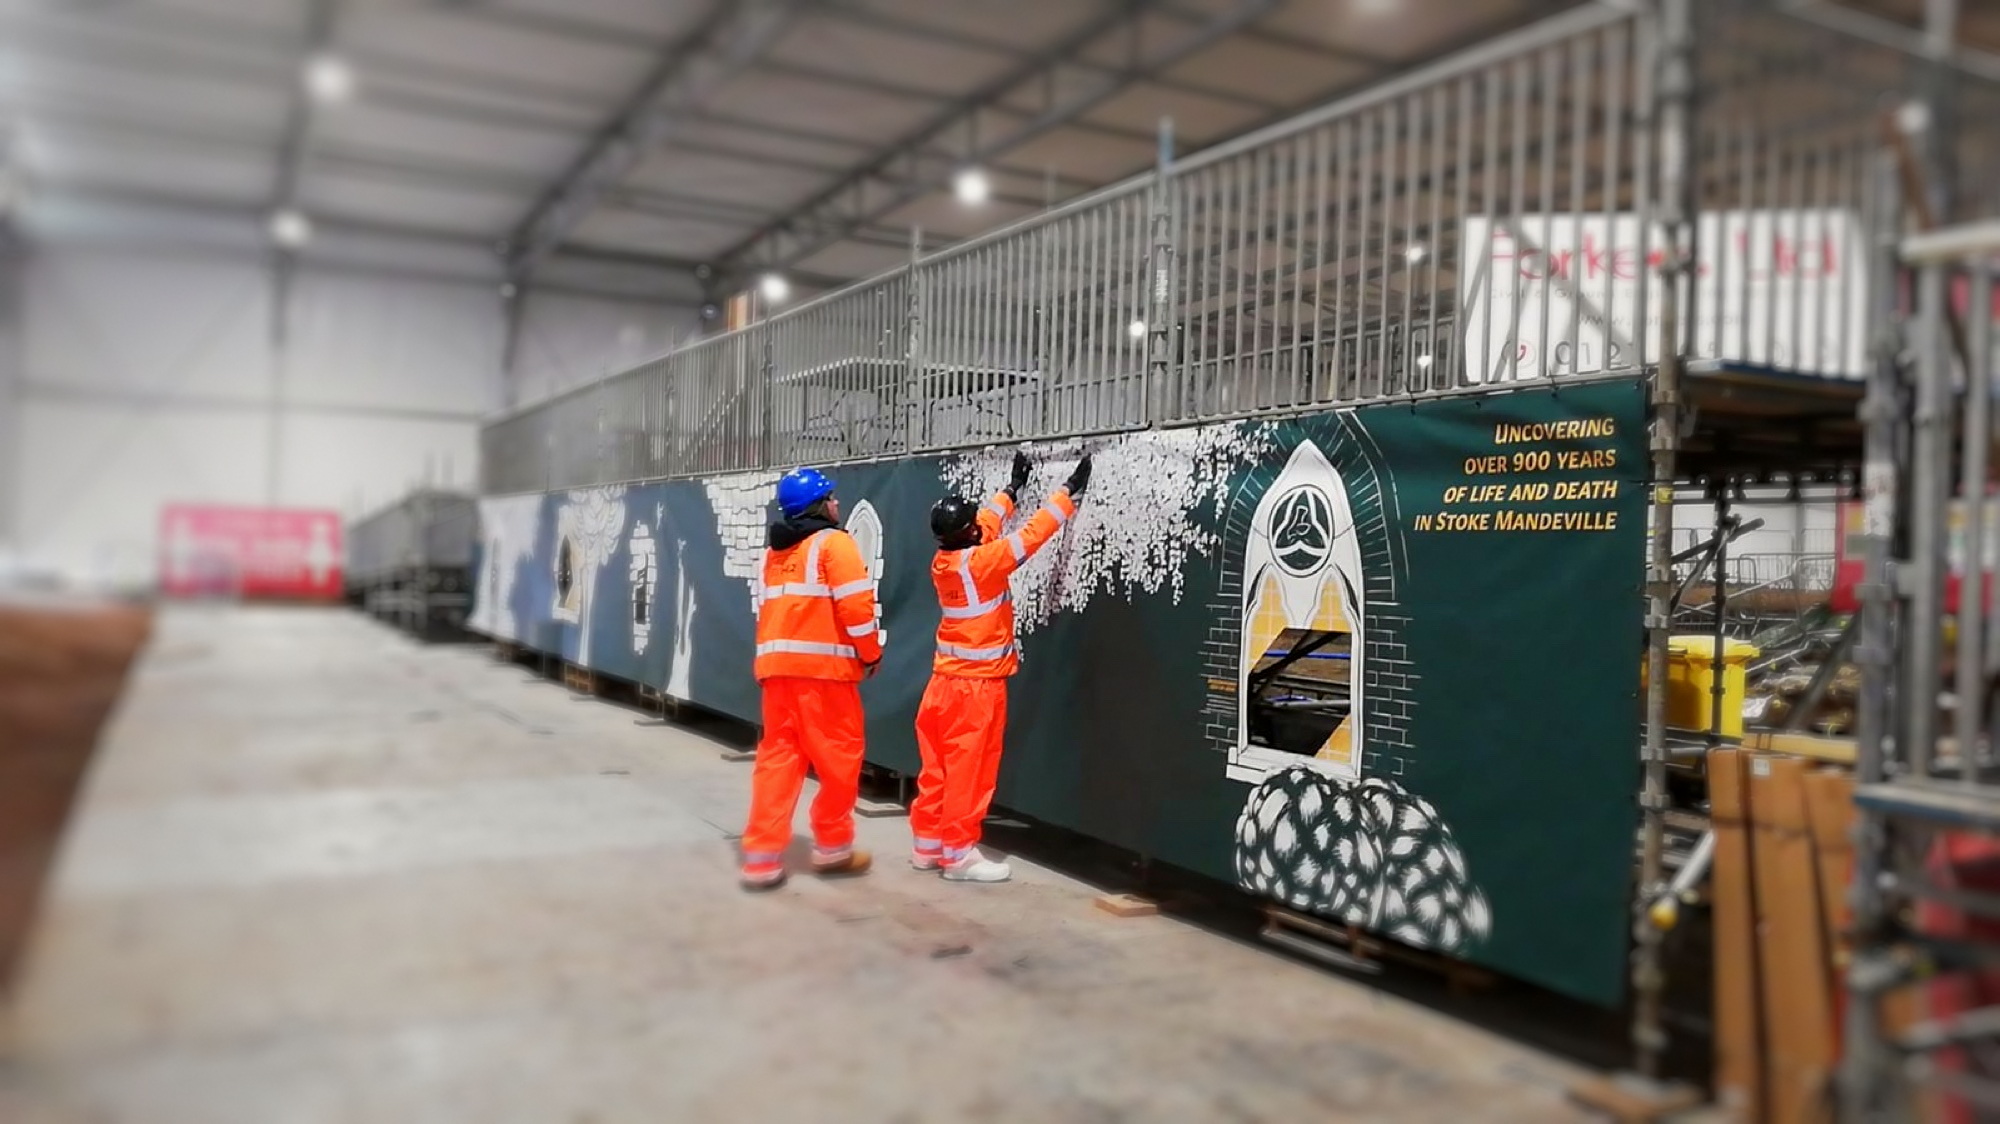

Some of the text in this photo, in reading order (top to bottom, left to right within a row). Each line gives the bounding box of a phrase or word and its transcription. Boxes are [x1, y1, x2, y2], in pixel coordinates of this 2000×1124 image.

[1495, 418, 1614, 444] UNCOVERING
[1464, 449, 1616, 475] OVER 900 YEARS
[1443, 480, 1618, 504] OF LIFE AND DEATH
[1414, 510, 1618, 531] IN STOKE MANDEVILLE
